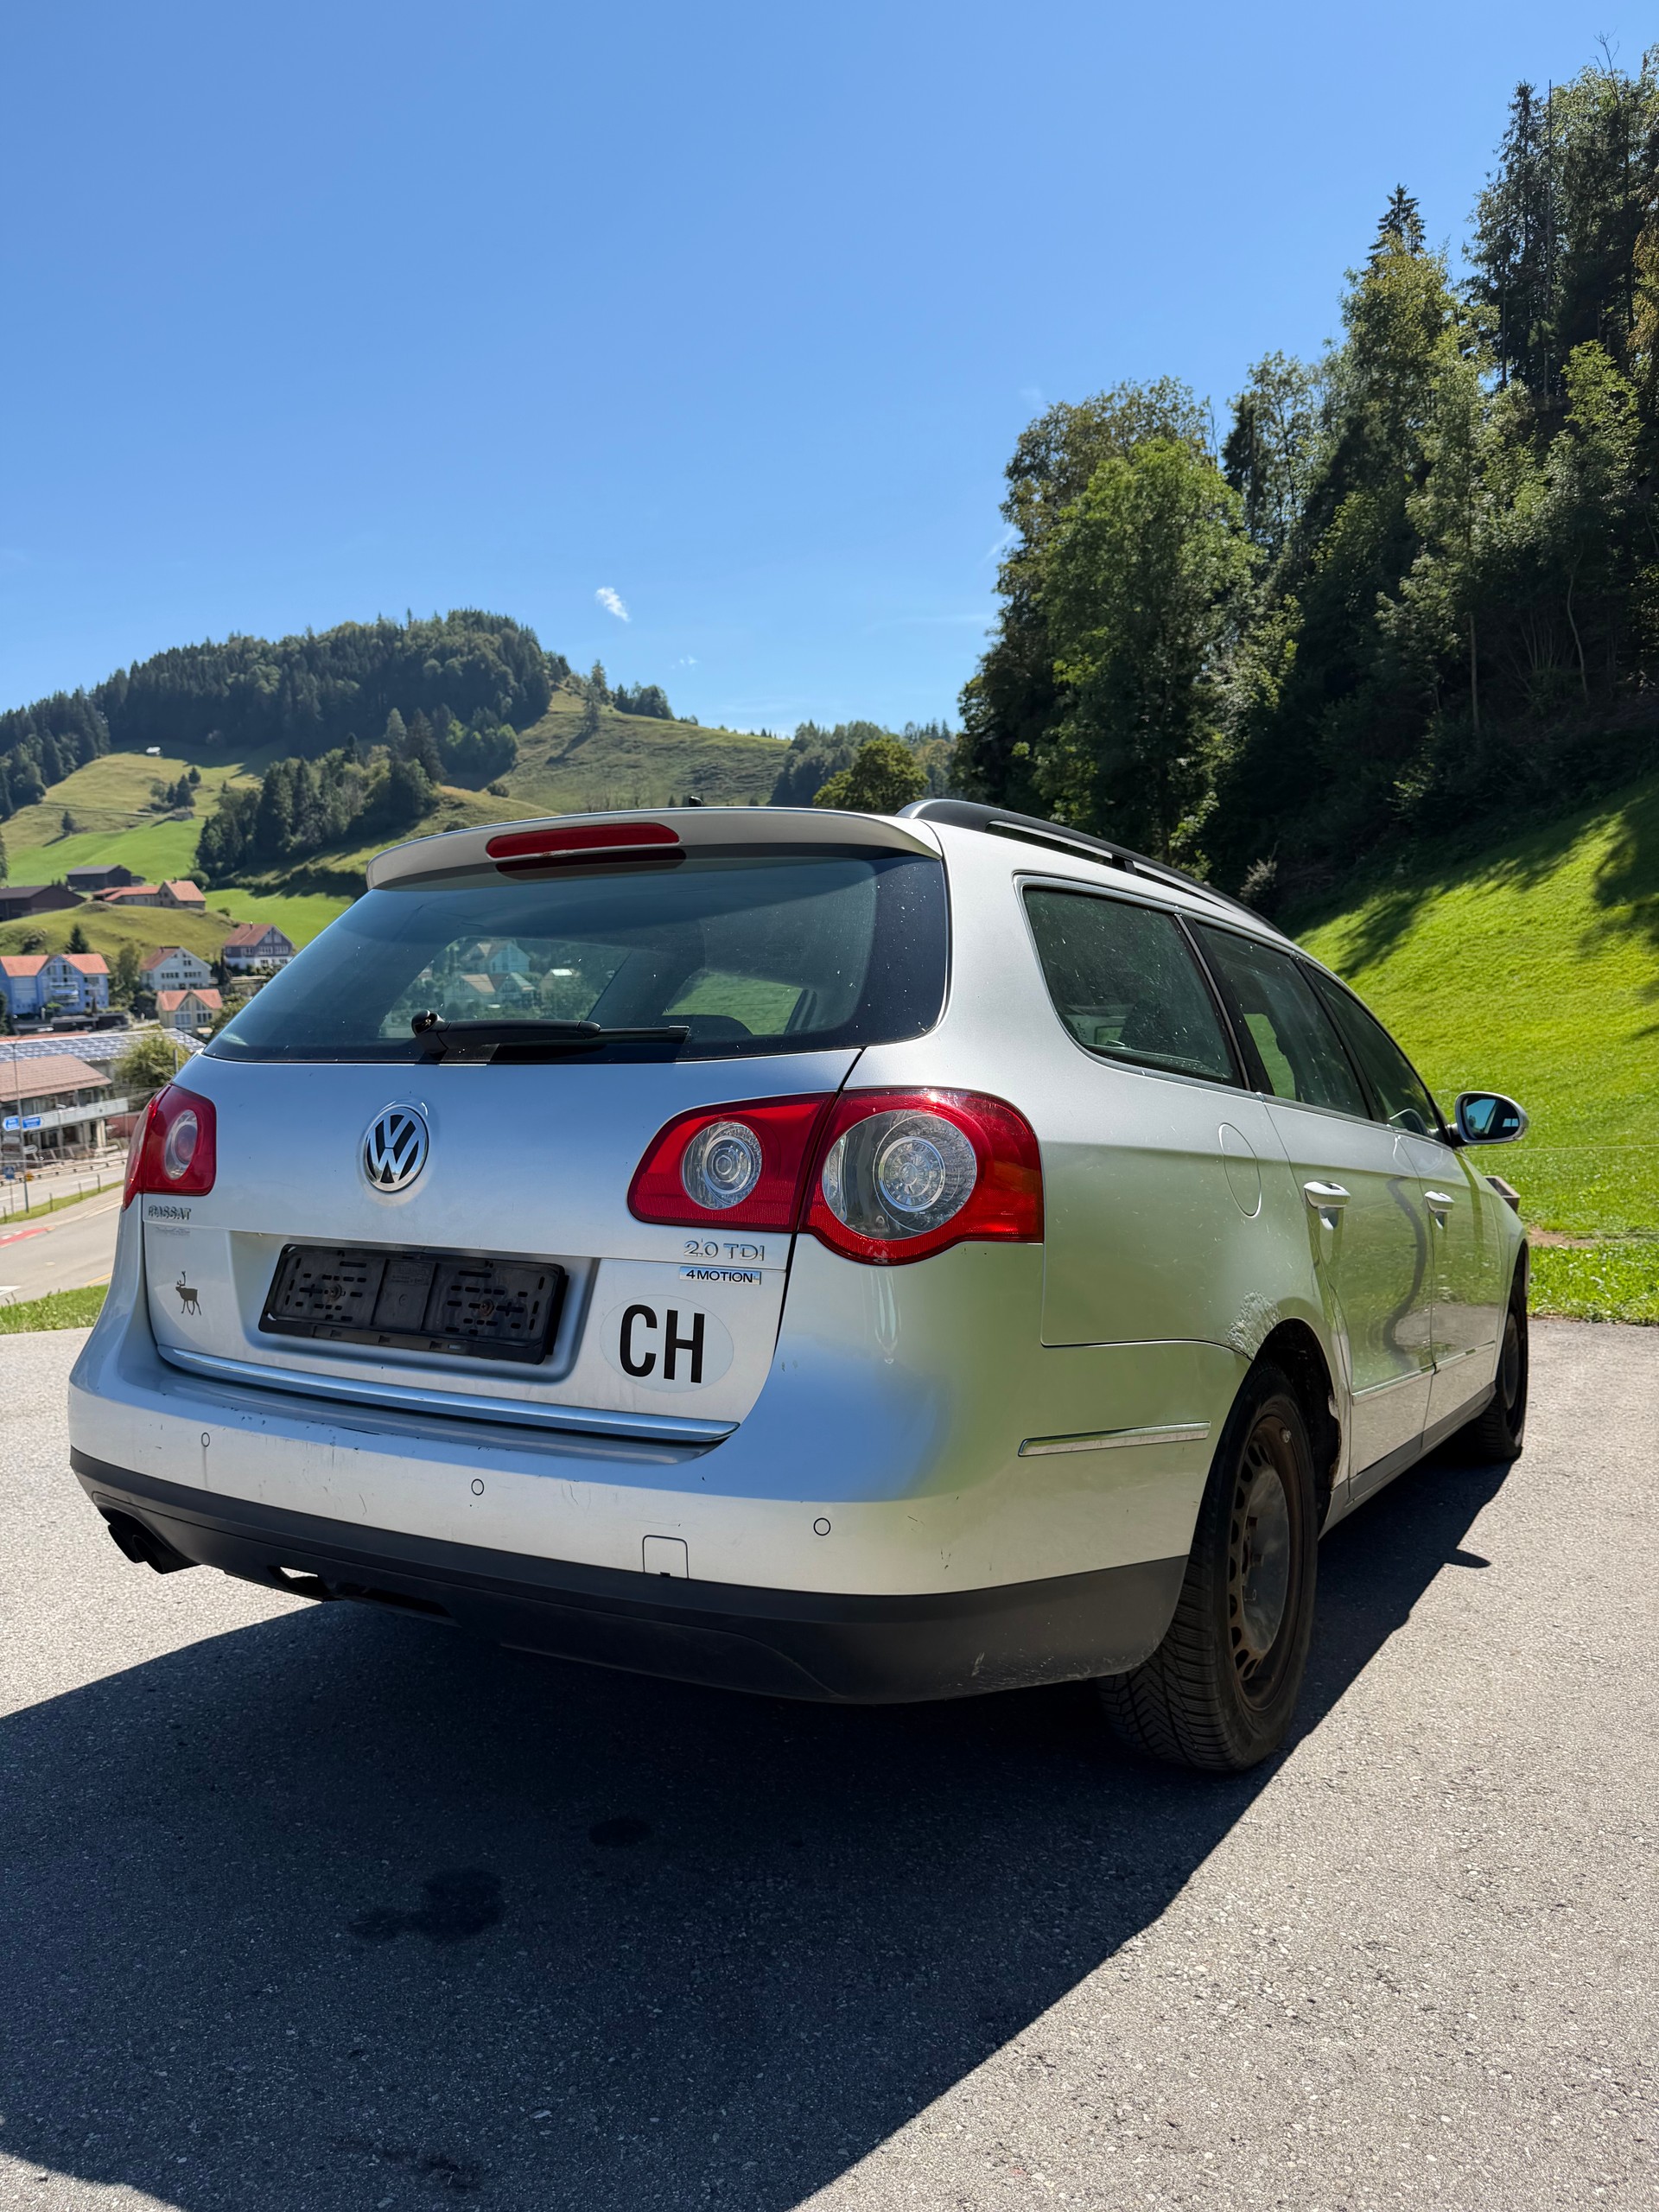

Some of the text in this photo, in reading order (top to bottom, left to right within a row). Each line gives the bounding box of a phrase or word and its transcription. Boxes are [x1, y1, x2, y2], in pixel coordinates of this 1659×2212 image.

[365, 1106, 429, 1192] VW
[148, 1205, 192, 1220] PASSAT
[683, 1240, 765, 1262] 2.0 TDI
[685, 1269, 753, 1283] 4MOTION
[620, 1304, 705, 1383] CH
